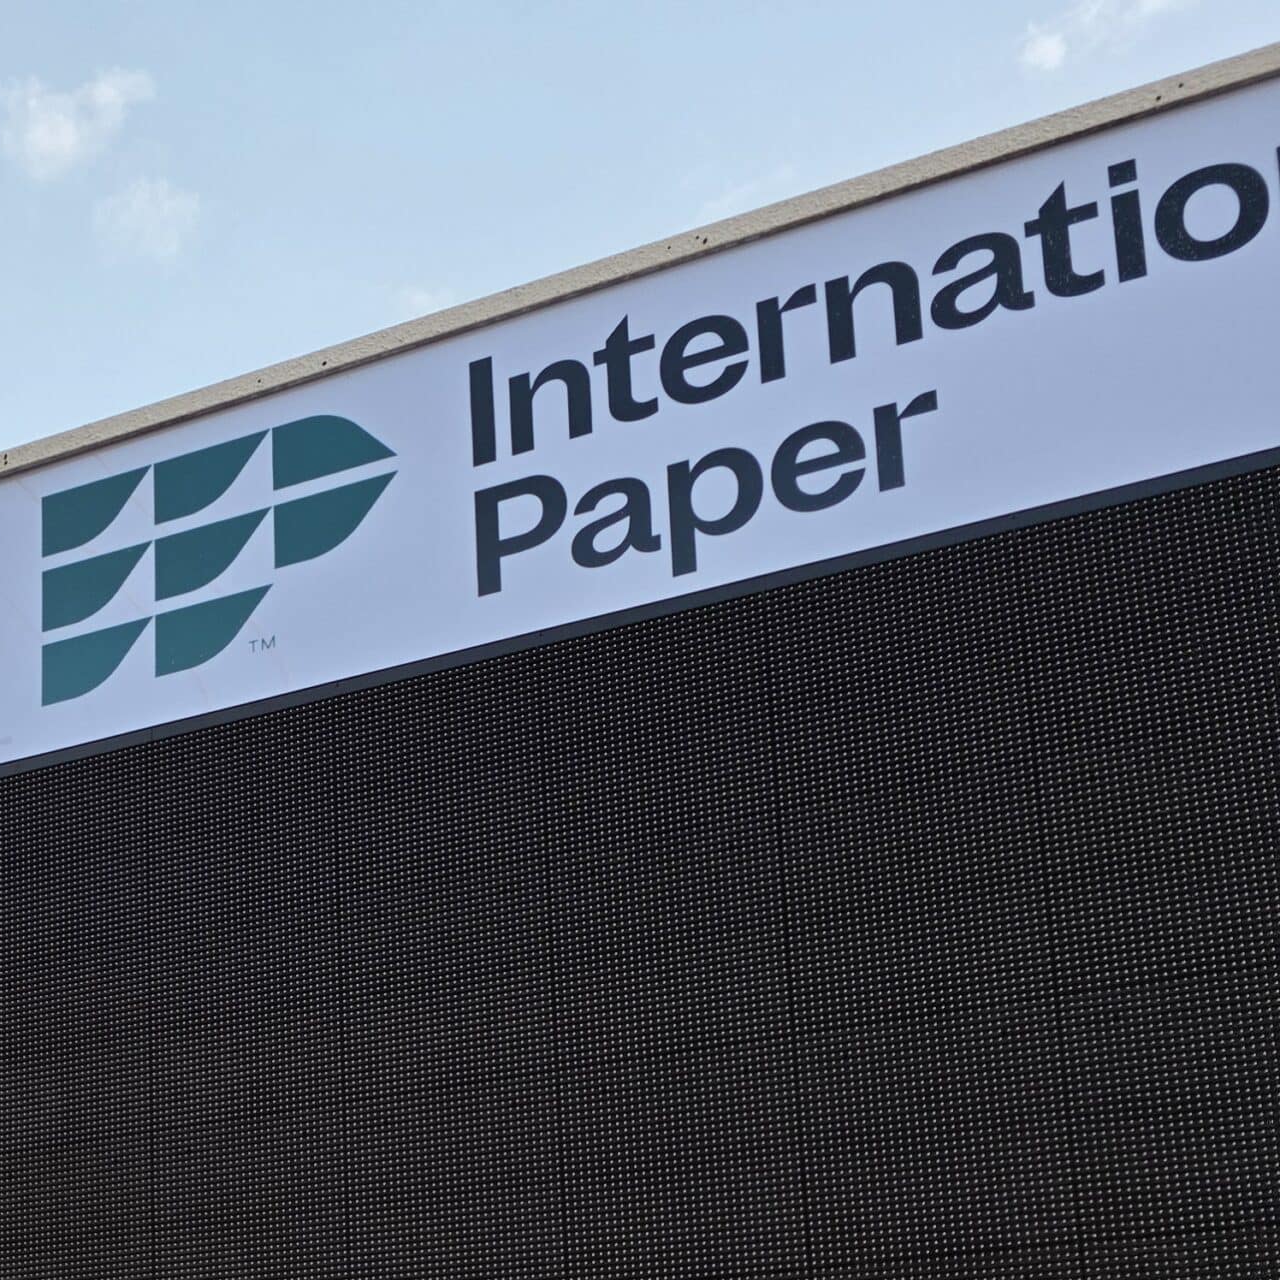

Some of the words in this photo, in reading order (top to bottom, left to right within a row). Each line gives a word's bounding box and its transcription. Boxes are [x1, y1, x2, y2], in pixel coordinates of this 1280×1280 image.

[468, 146, 1280, 467] Internatio
[474, 389, 938, 597] Paper
[248, 635, 277, 654] TM
